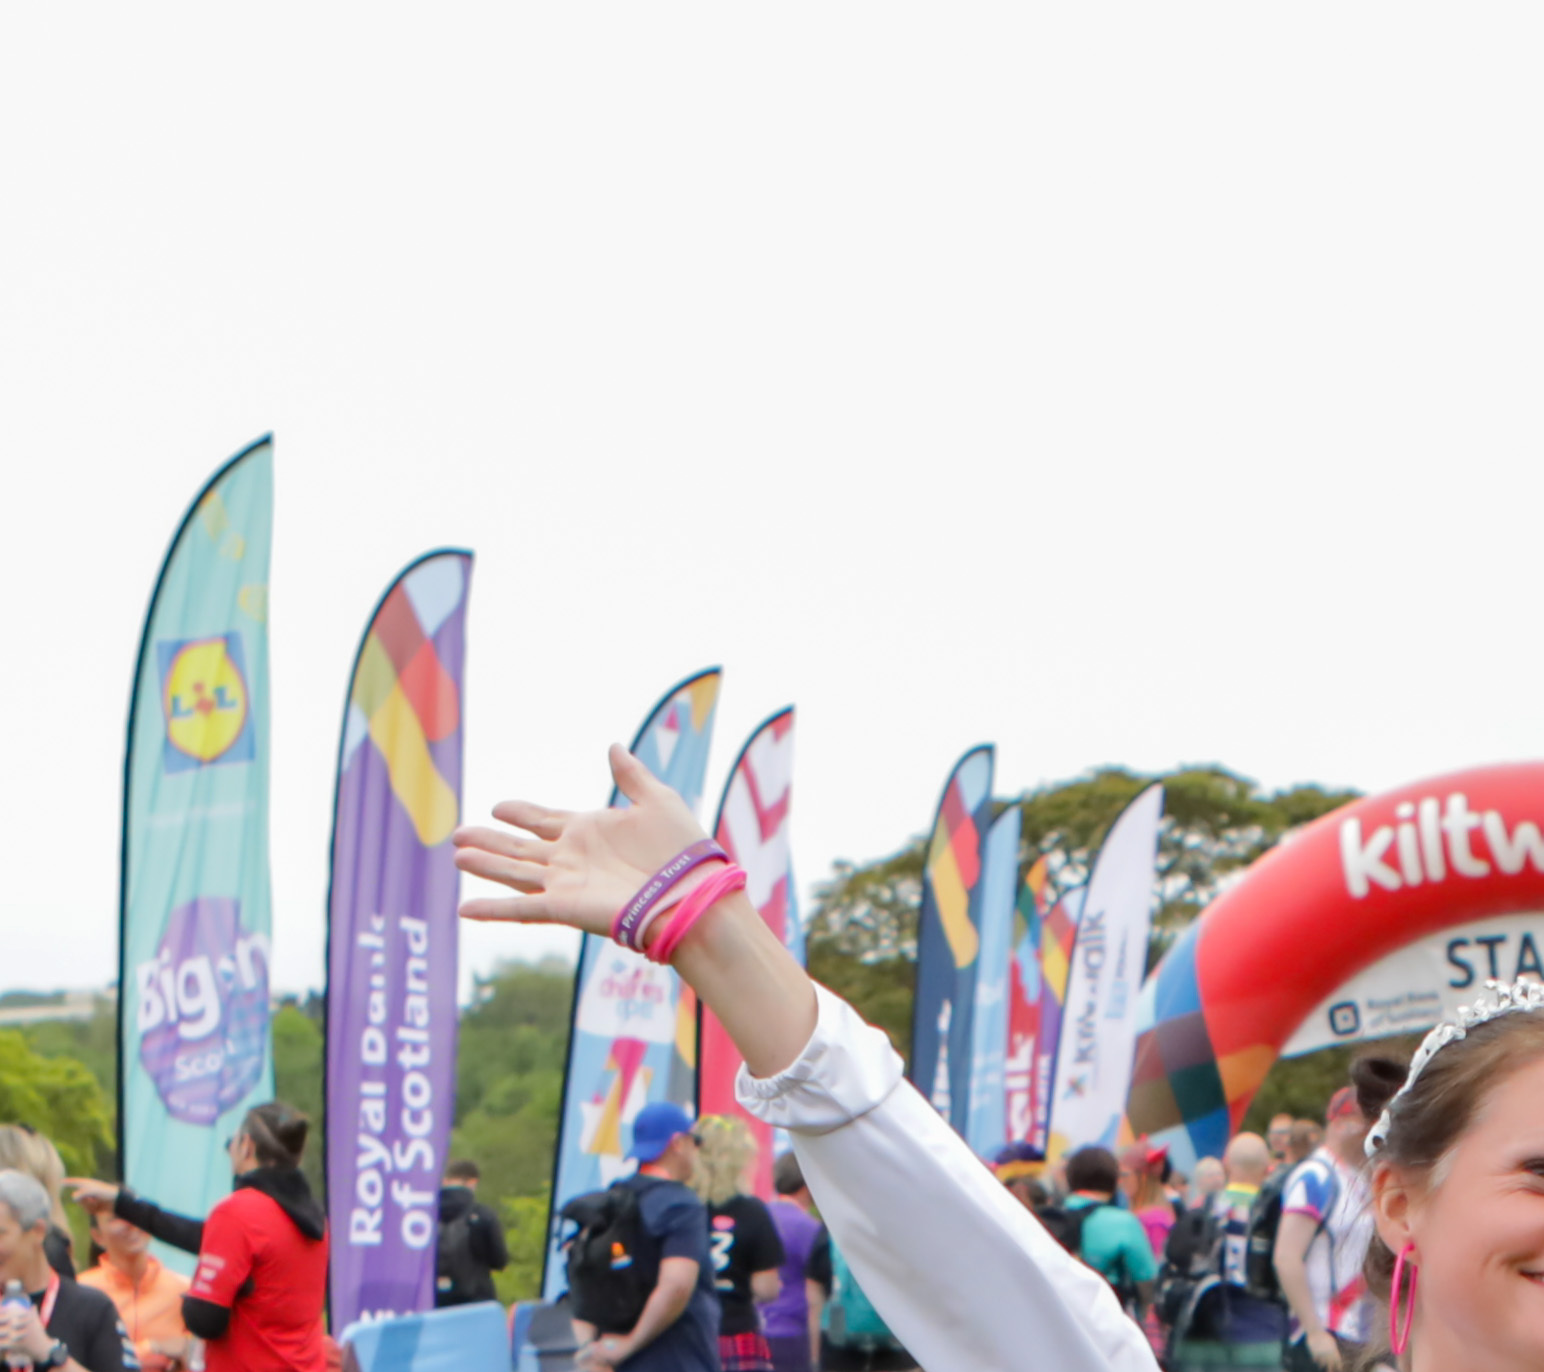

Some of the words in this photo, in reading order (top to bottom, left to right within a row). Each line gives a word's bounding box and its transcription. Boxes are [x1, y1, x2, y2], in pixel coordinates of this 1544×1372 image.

[622, 880, 663, 928] Princess
[660, 854, 692, 879] Trust
[137, 947, 221, 1041] Big
[394, 915, 435, 1173] Scotland
[349, 1081, 393, 1247] Royal
[392, 1179, 434, 1250] of
